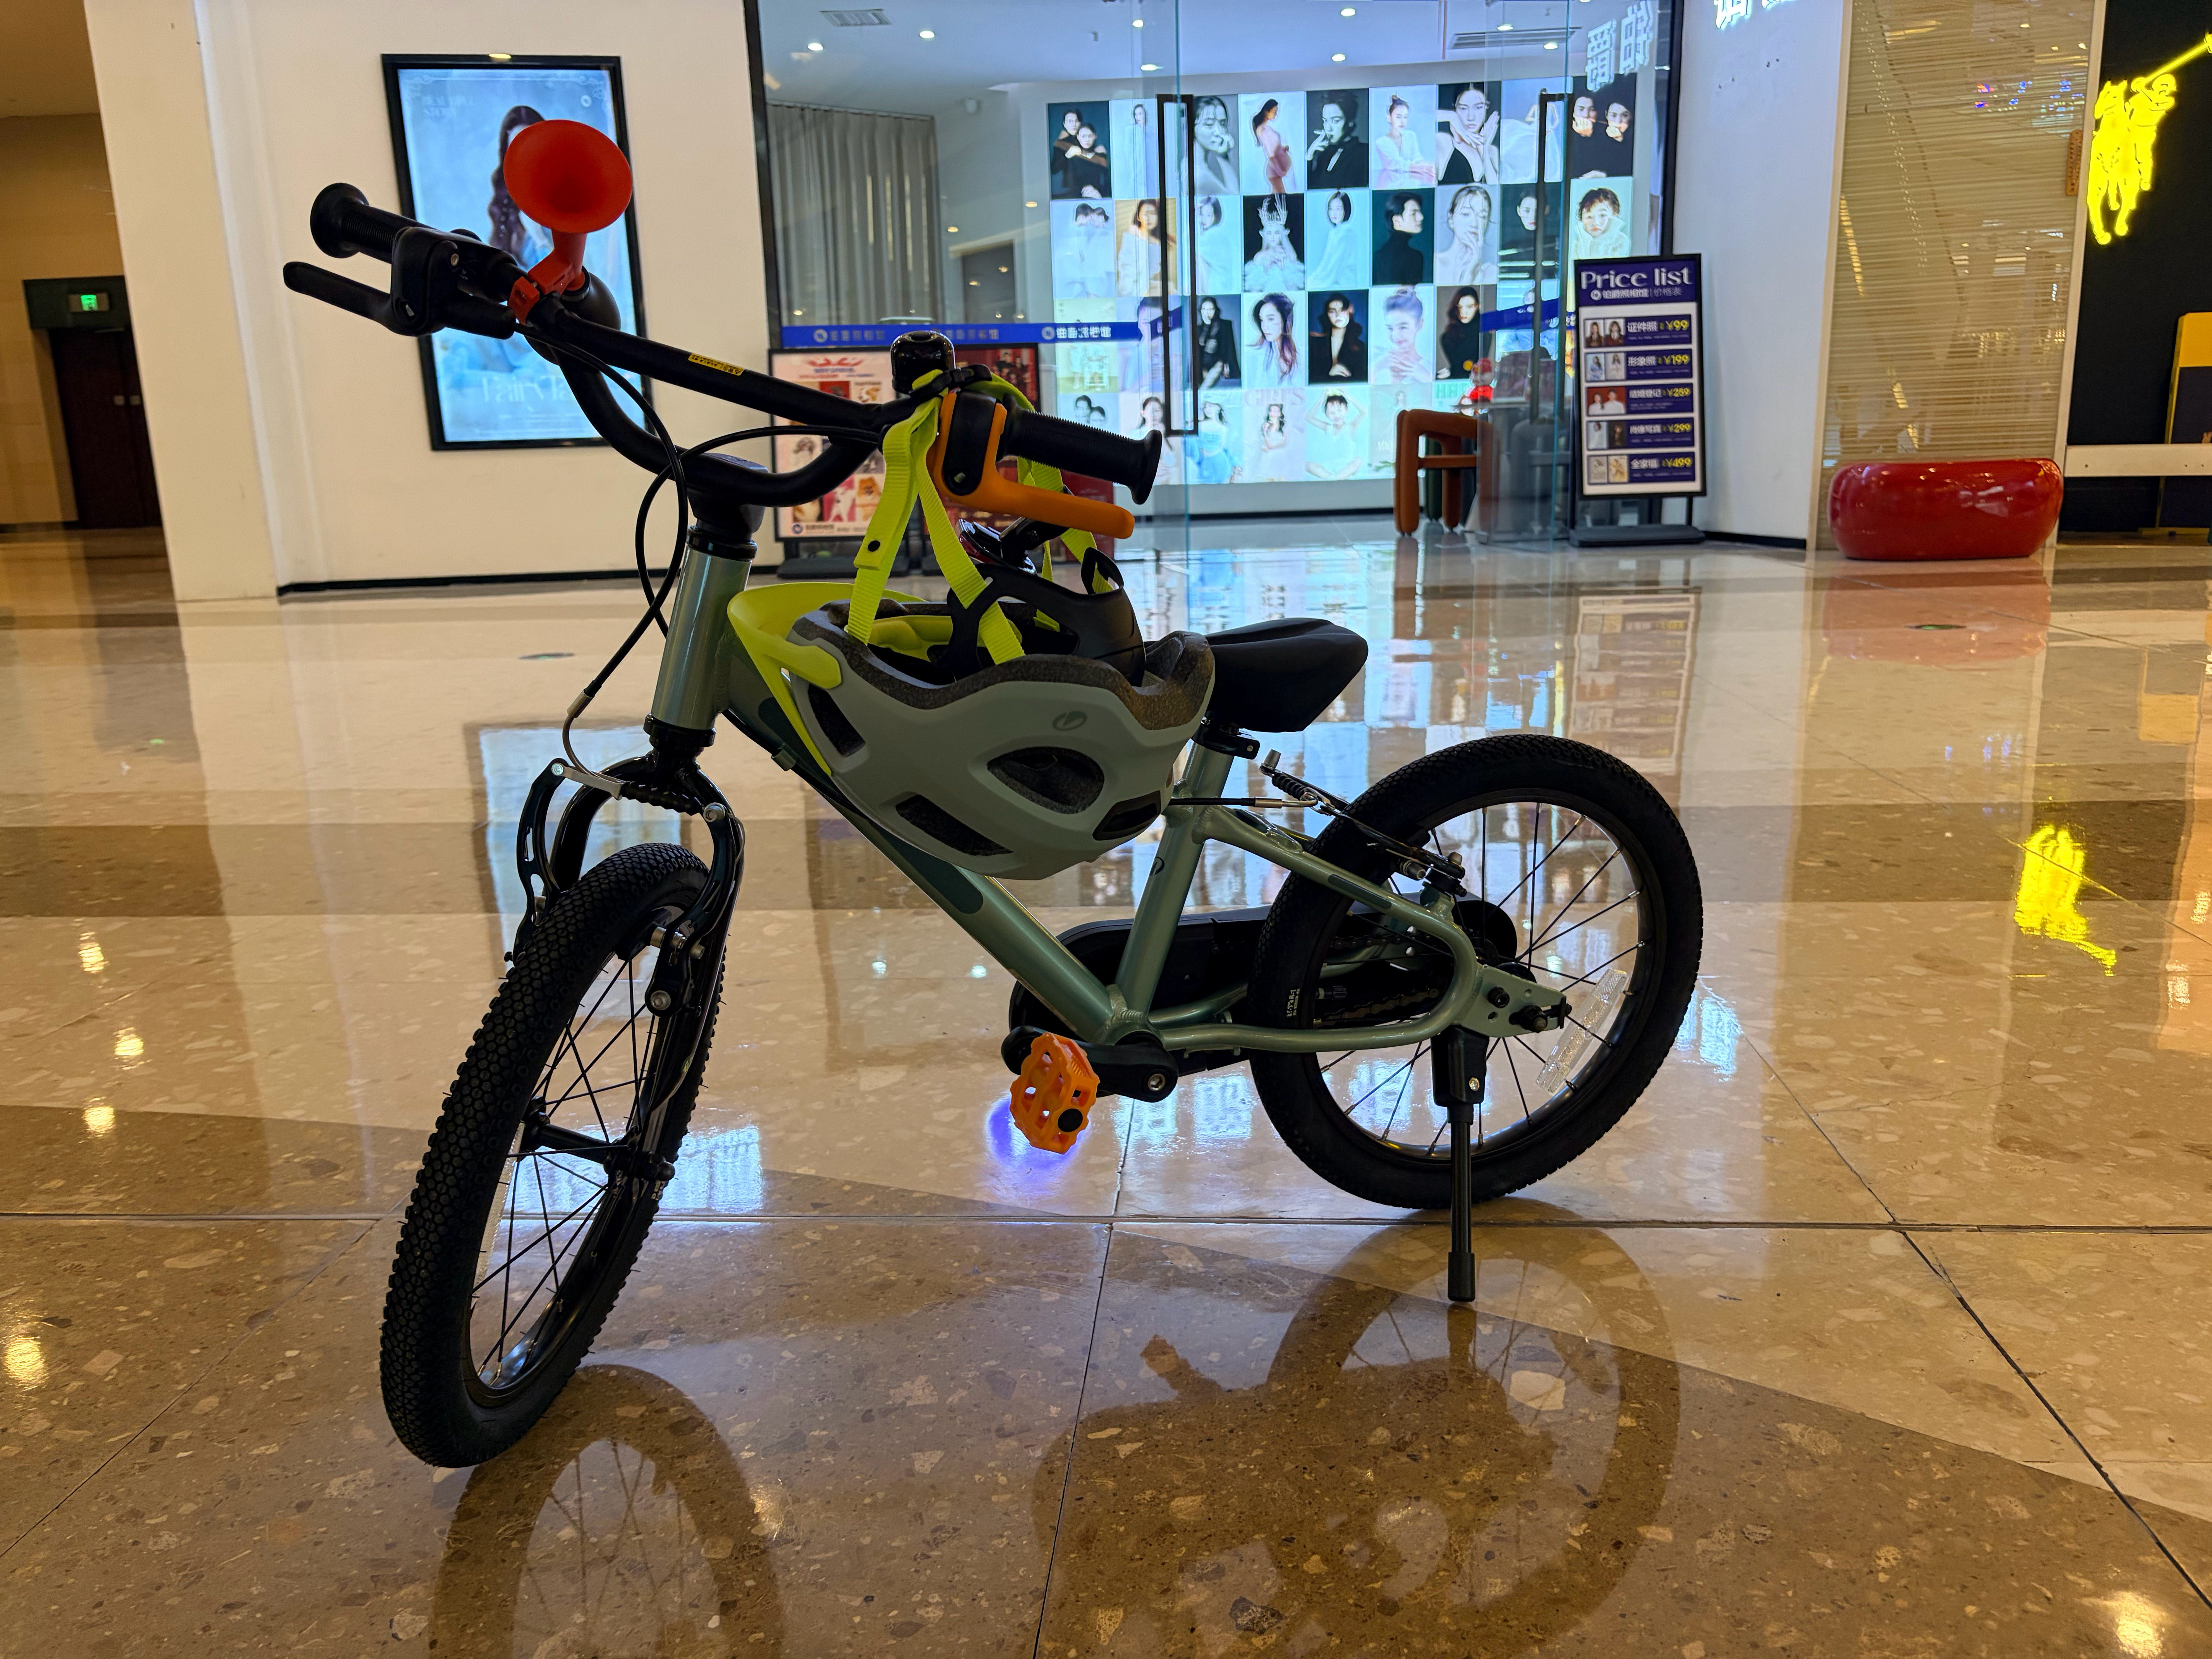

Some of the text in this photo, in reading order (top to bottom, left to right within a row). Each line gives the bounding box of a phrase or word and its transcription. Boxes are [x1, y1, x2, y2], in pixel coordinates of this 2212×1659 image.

[1580, 266, 1694, 290] Price list
[1653, 287, 1683, 297] 价格表
[1627, 320, 1658, 333] 证件照
[1665, 319, 1689, 331] ¥99
[1628, 355, 1657, 367] 形象照
